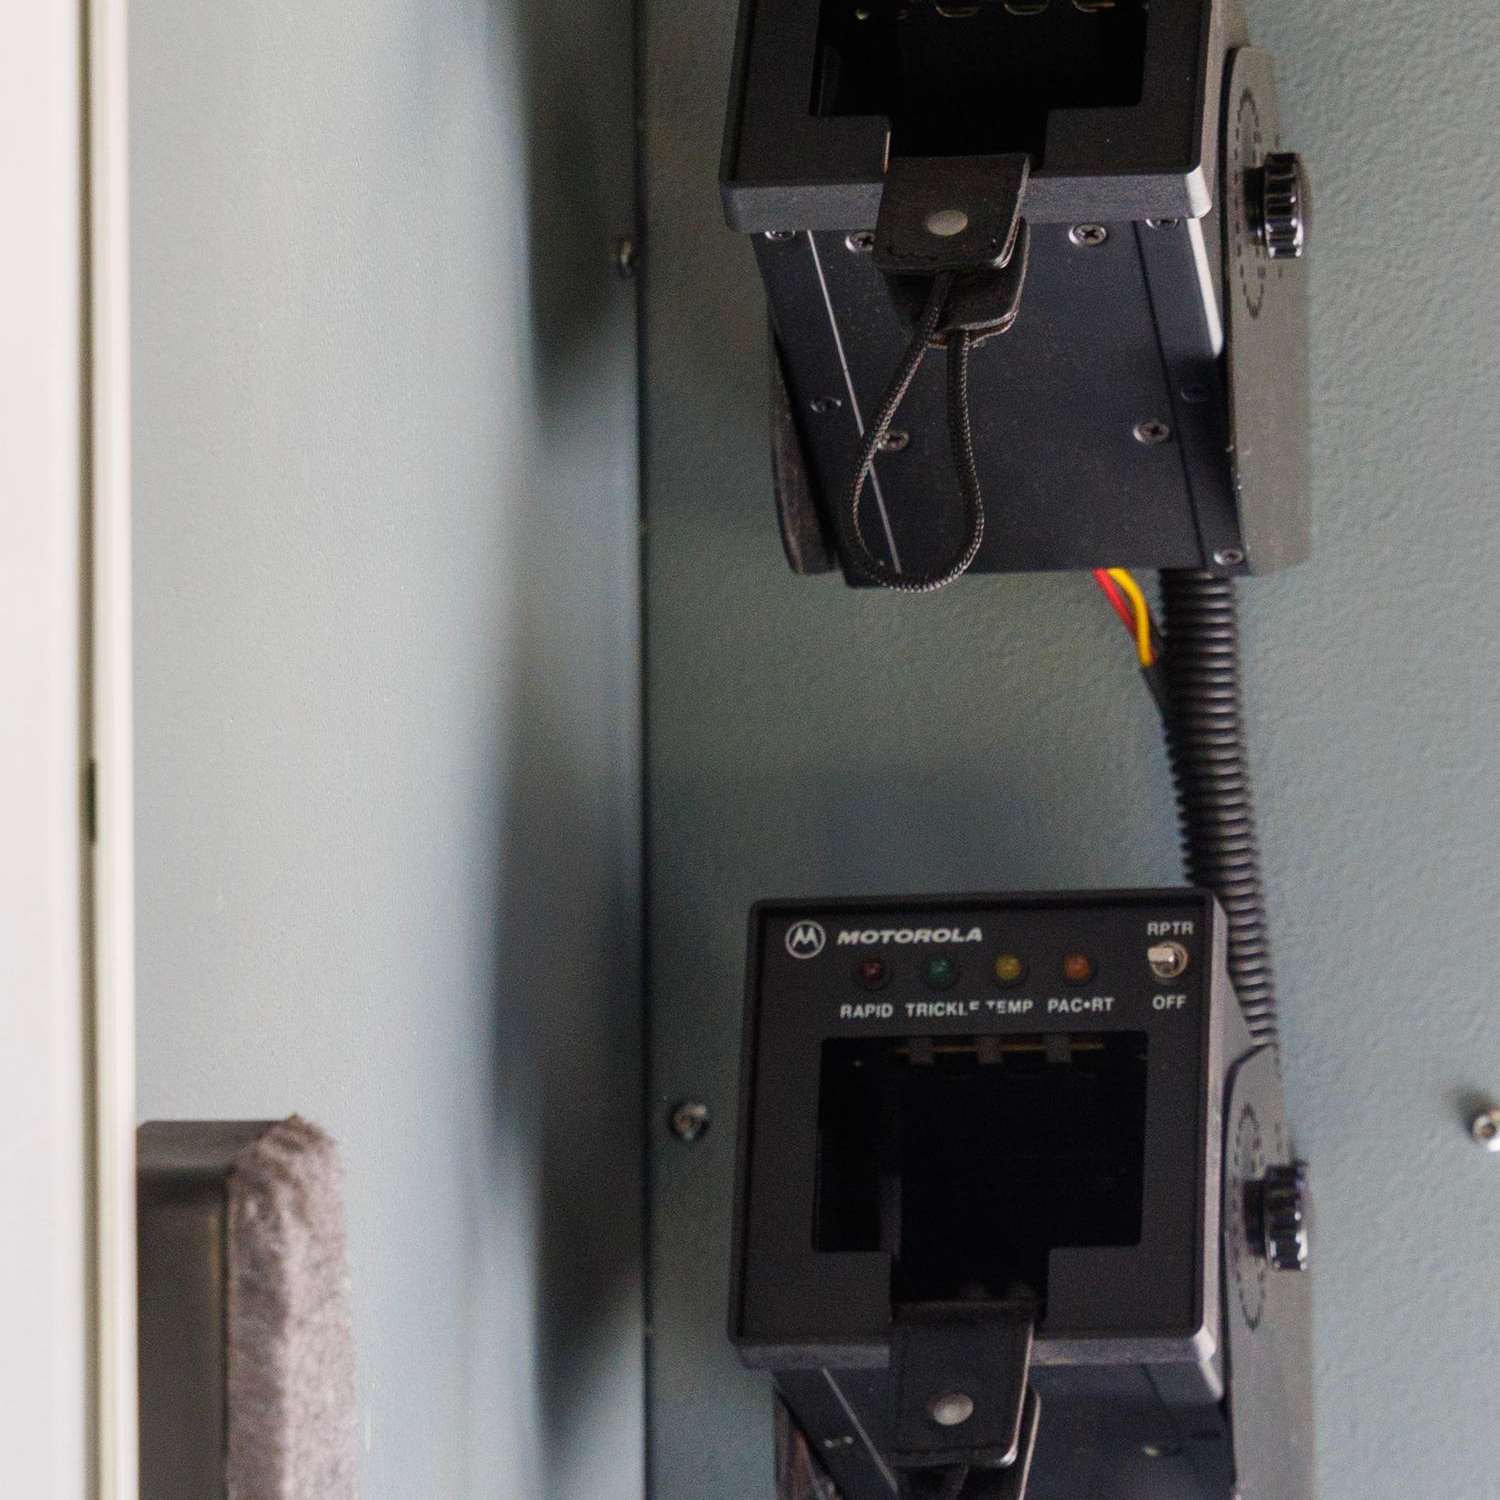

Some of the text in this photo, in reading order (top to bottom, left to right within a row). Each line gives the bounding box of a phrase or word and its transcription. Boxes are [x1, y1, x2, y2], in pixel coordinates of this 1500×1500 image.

[836, 927, 983, 945] MOTOROLA
[1147, 921, 1195, 936] RPTR
[840, 1003, 894, 1019] RAPID
[985, 1000, 1034, 1014] TEMP
[1152, 995, 1187, 1010] OFF
